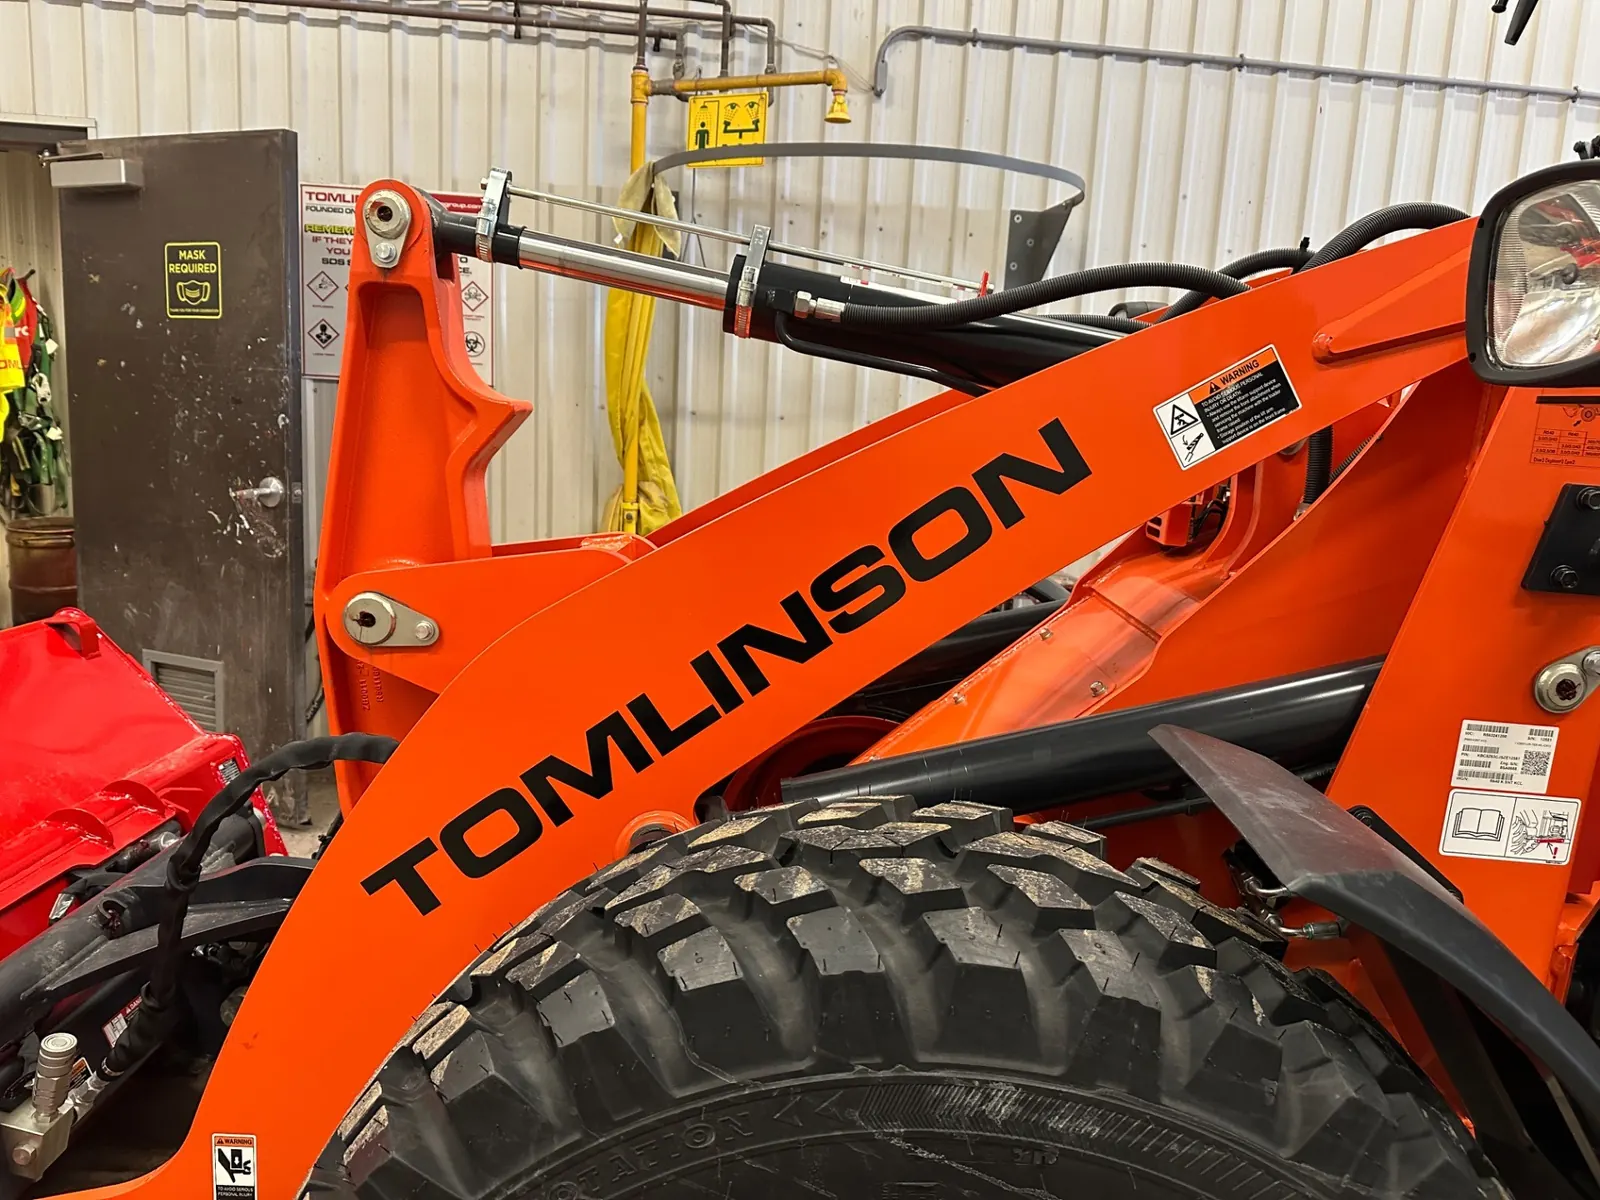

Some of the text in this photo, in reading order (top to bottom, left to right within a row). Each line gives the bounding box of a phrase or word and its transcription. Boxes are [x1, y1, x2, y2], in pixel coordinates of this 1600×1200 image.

[306, 206, 344, 214] FOUNDED
[324, 236, 354, 244] THEY
[178, 250, 206, 260] MASK
[168, 264, 217, 273] REQUIRED
[1220, 360, 1259, 385] WARNING
[1240, 371, 1262, 386] PERSONAL
[363, 418, 1092, 916] TOMLINSON
